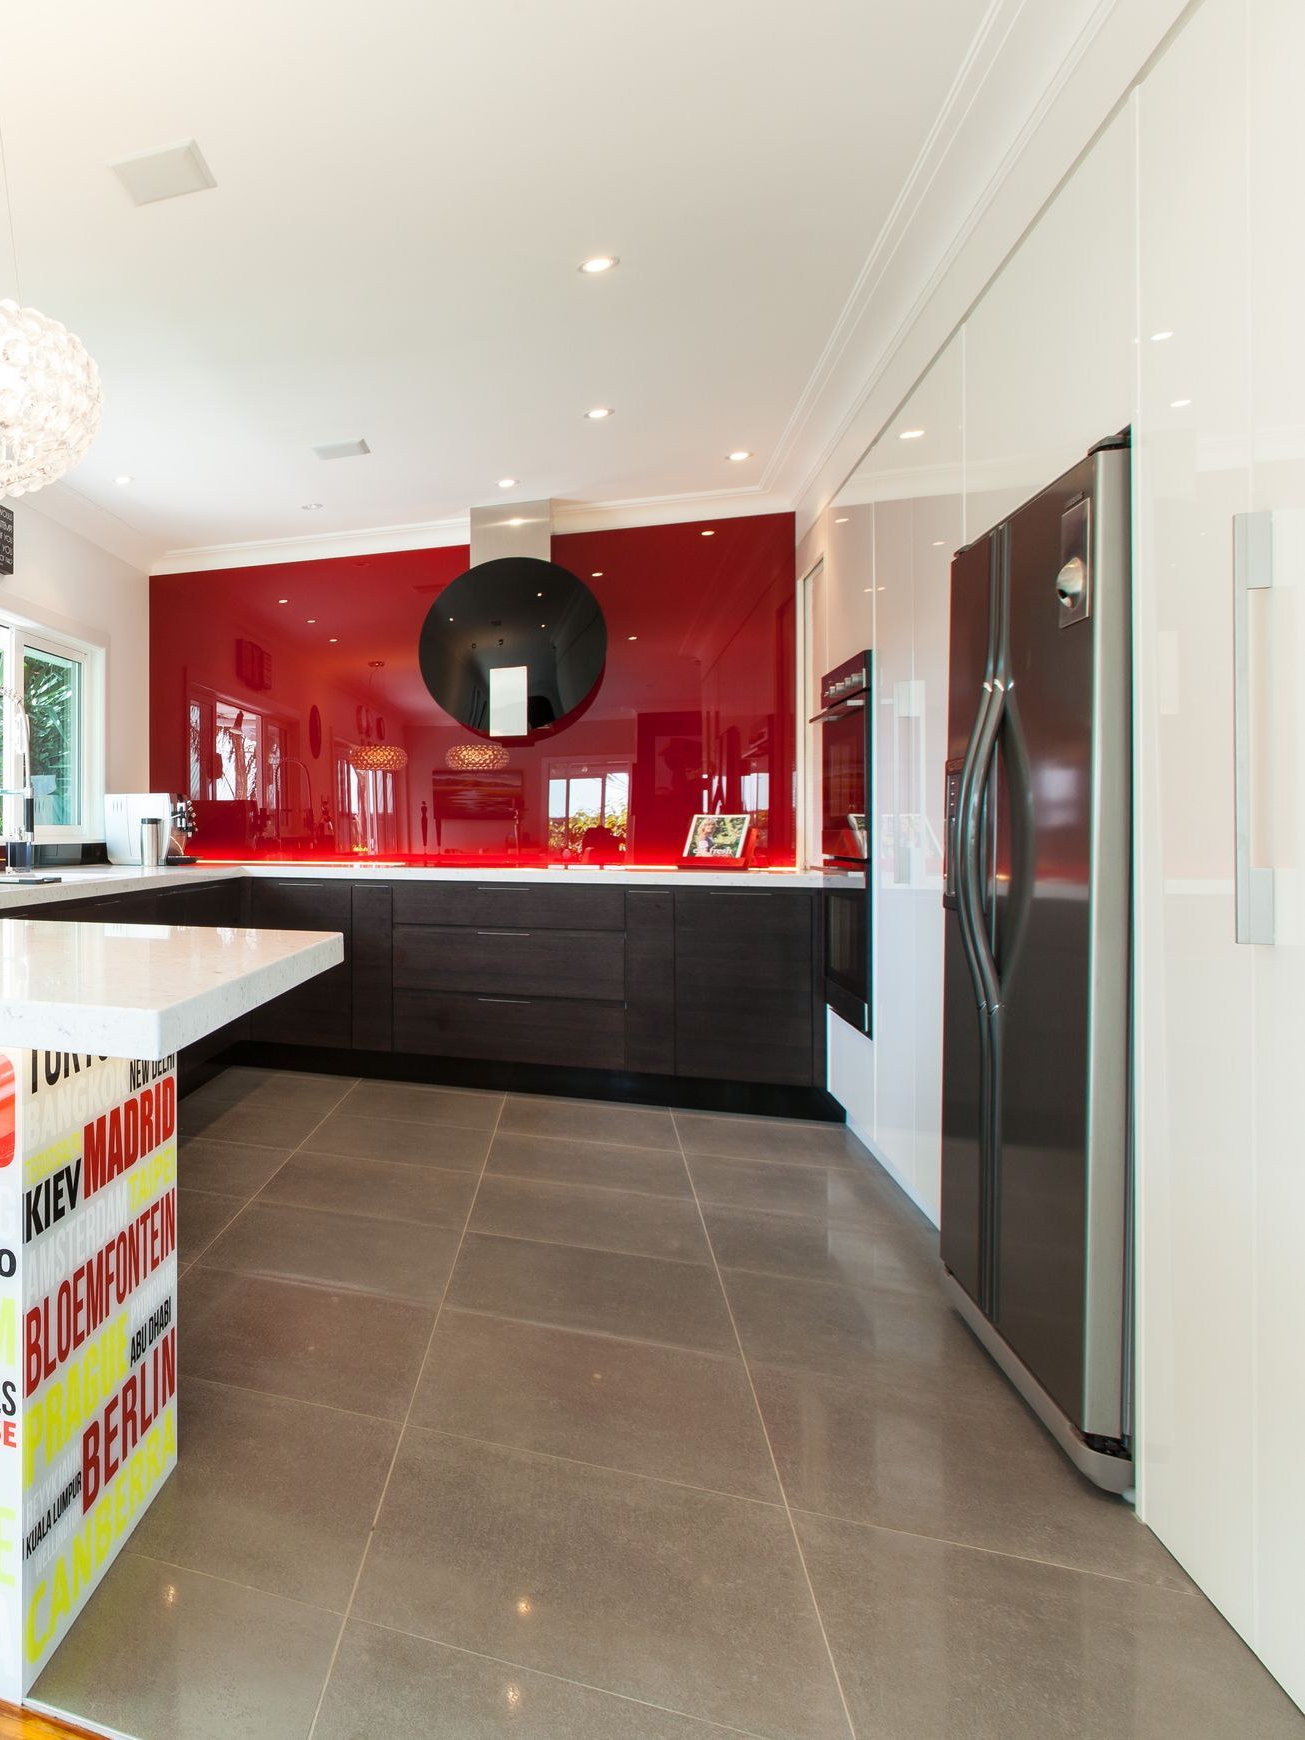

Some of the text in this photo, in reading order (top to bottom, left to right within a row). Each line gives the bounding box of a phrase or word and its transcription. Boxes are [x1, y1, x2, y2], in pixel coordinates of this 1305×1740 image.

[25, 1062, 128, 1148] BANGKOK
[130, 1059, 149, 1092] NEW
[84, 1076, 175, 1200] MADRID
[128, 1145, 176, 1213] TAIPEI
[26, 1158, 82, 1243] KIEV
[26, 1181, 128, 1299] AMSTERDAM
[26, 1187, 175, 1398] BLOEMFONTEIN
[131, 1296, 171, 1367] ABU DHABI
[23, 1311, 128, 1489] PRAGUE
[83, 1327, 175, 1515] BERLIN
[26, 1470, 82, 1559] KUALA LUMPUR
[26, 1408, 176, 1664] CANBERRA
